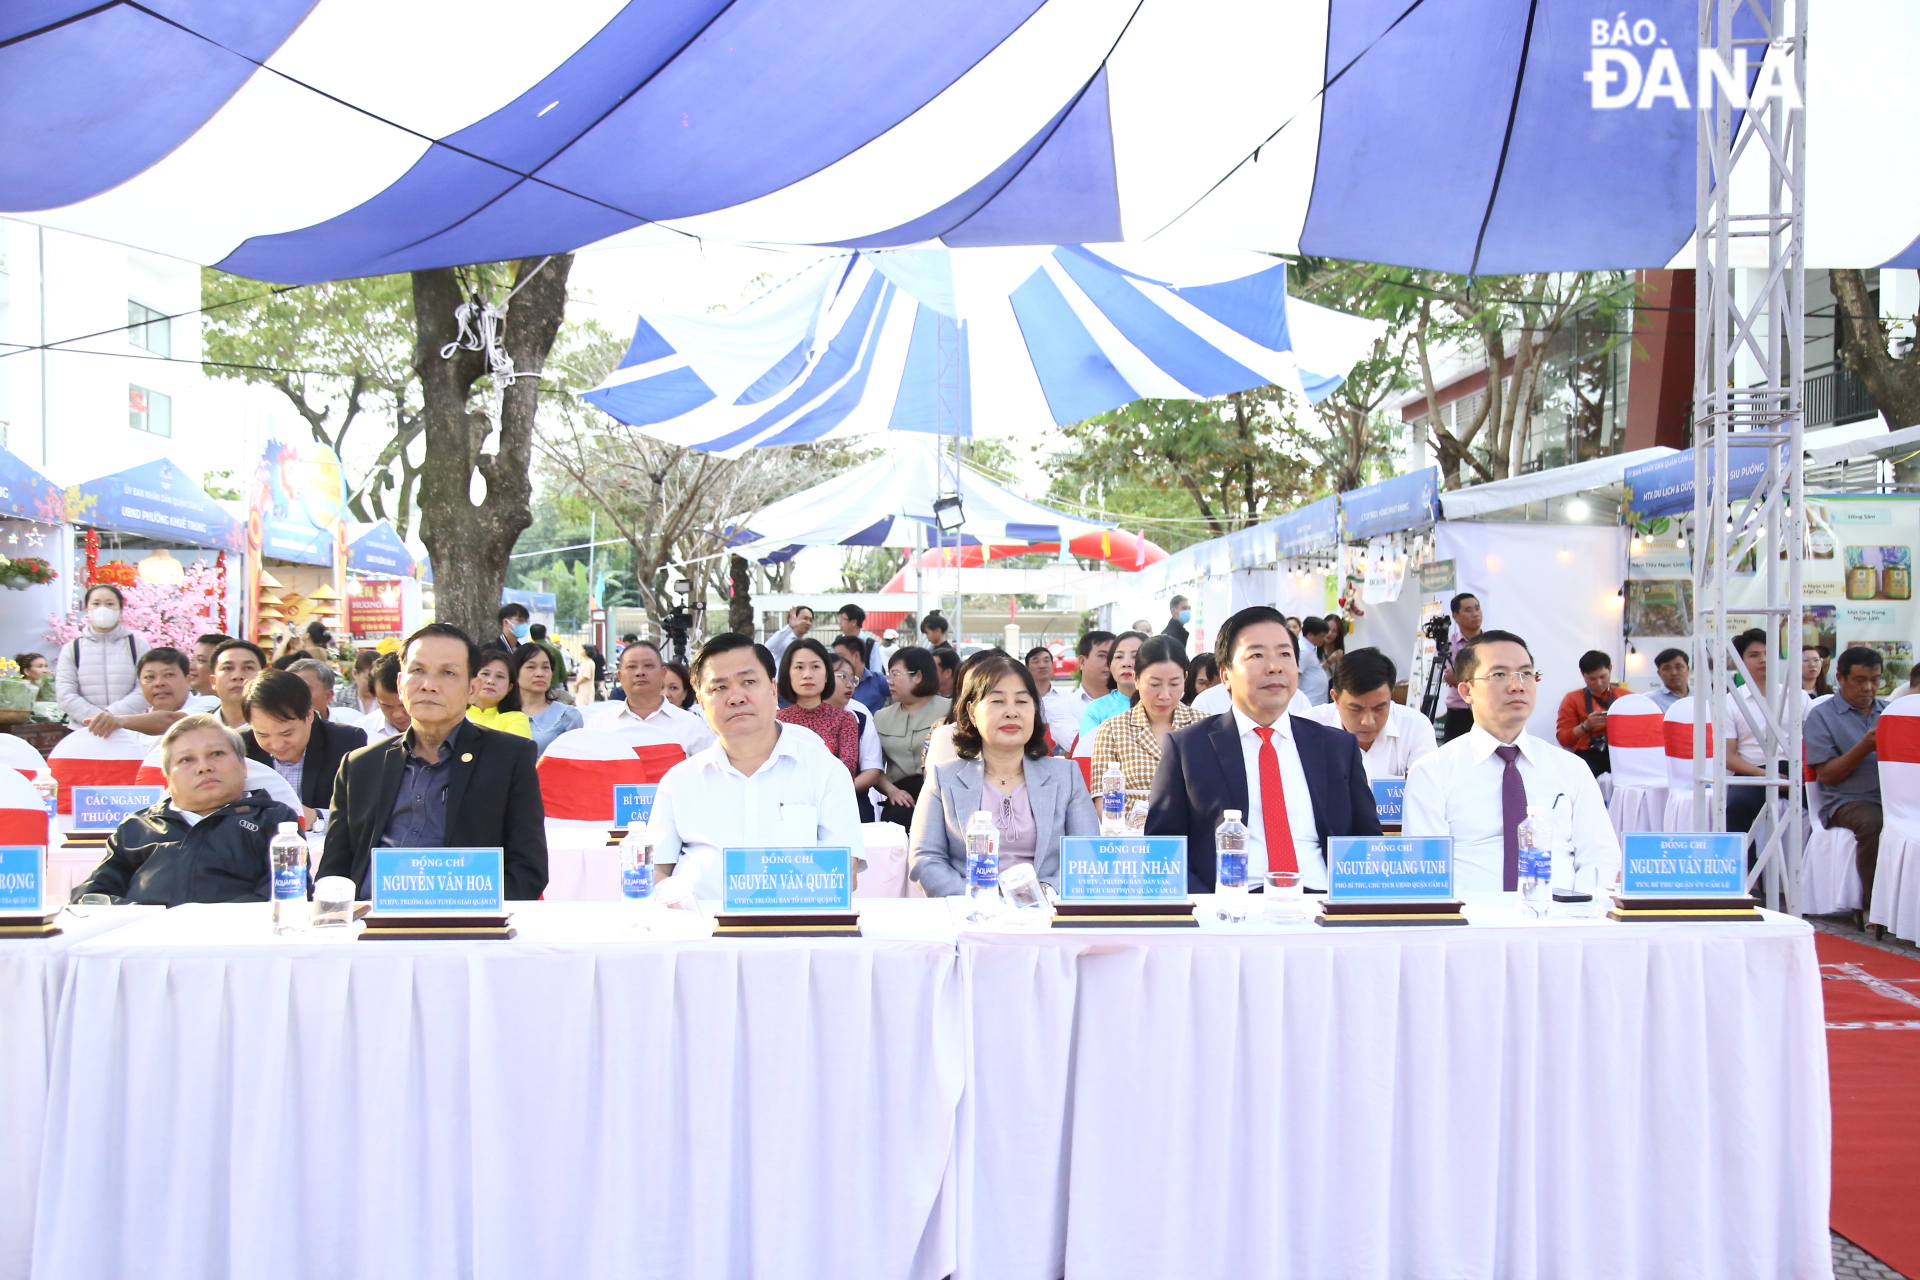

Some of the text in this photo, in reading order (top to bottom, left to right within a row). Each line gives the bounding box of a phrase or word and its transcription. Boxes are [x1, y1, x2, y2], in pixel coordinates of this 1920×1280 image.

[1643, 492, 1654, 502] HTX
[1654, 489, 1662, 499] DU
[1662, 486, 1675, 498] LỊCH
[1676, 486, 1680, 494] &
[1730, 469, 1740, 480] SIU
[133, 486, 144, 498] BAN
[121, 506, 141, 520] UBND
[142, 510, 169, 526] PHƯỜNG
[187, 520, 207, 534] TRUNG
[85, 793, 150, 806] CÁC NGÀNH
[623, 794, 652, 805] BÍ THƯ
[1376, 802, 1401, 816] QUẬN
[82, 810, 120, 824] THUỘC
[631, 810, 648, 821] CÁC
[1099, 842, 1150, 854] ĐỒNG CHÍ
[1371, 844, 1412, 852] ĐỒNG CHÍ
[1660, 838, 1707, 849] ĐỒNG CHÍ
[412, 856, 464, 867] ĐỒNG CHÍ
[762, 853, 814, 864] ĐỒNG CHÍ
[1630, 850, 1737, 875] NGUYỄN VĂN HÙNG
[1068, 857, 1181, 879] PHẠM THỊ NHÀN
[1336, 853, 1446, 877] NGUYỄN QUANG VINH
[382, 867, 493, 891] NGUYỄN VĂN HOA
[730, 866, 844, 892] NGUYỄN VĂN QUYẾT
[1381, 881, 1394, 890] TỊCH
[1412, 880, 1428, 889] QUẬN
[1086, 887, 1101, 896] TỊCH
[1137, 886, 1153, 896] QUẬN
[472, 897, 488, 906] QUẬN
[816, 896, 834, 905] QUẬN
